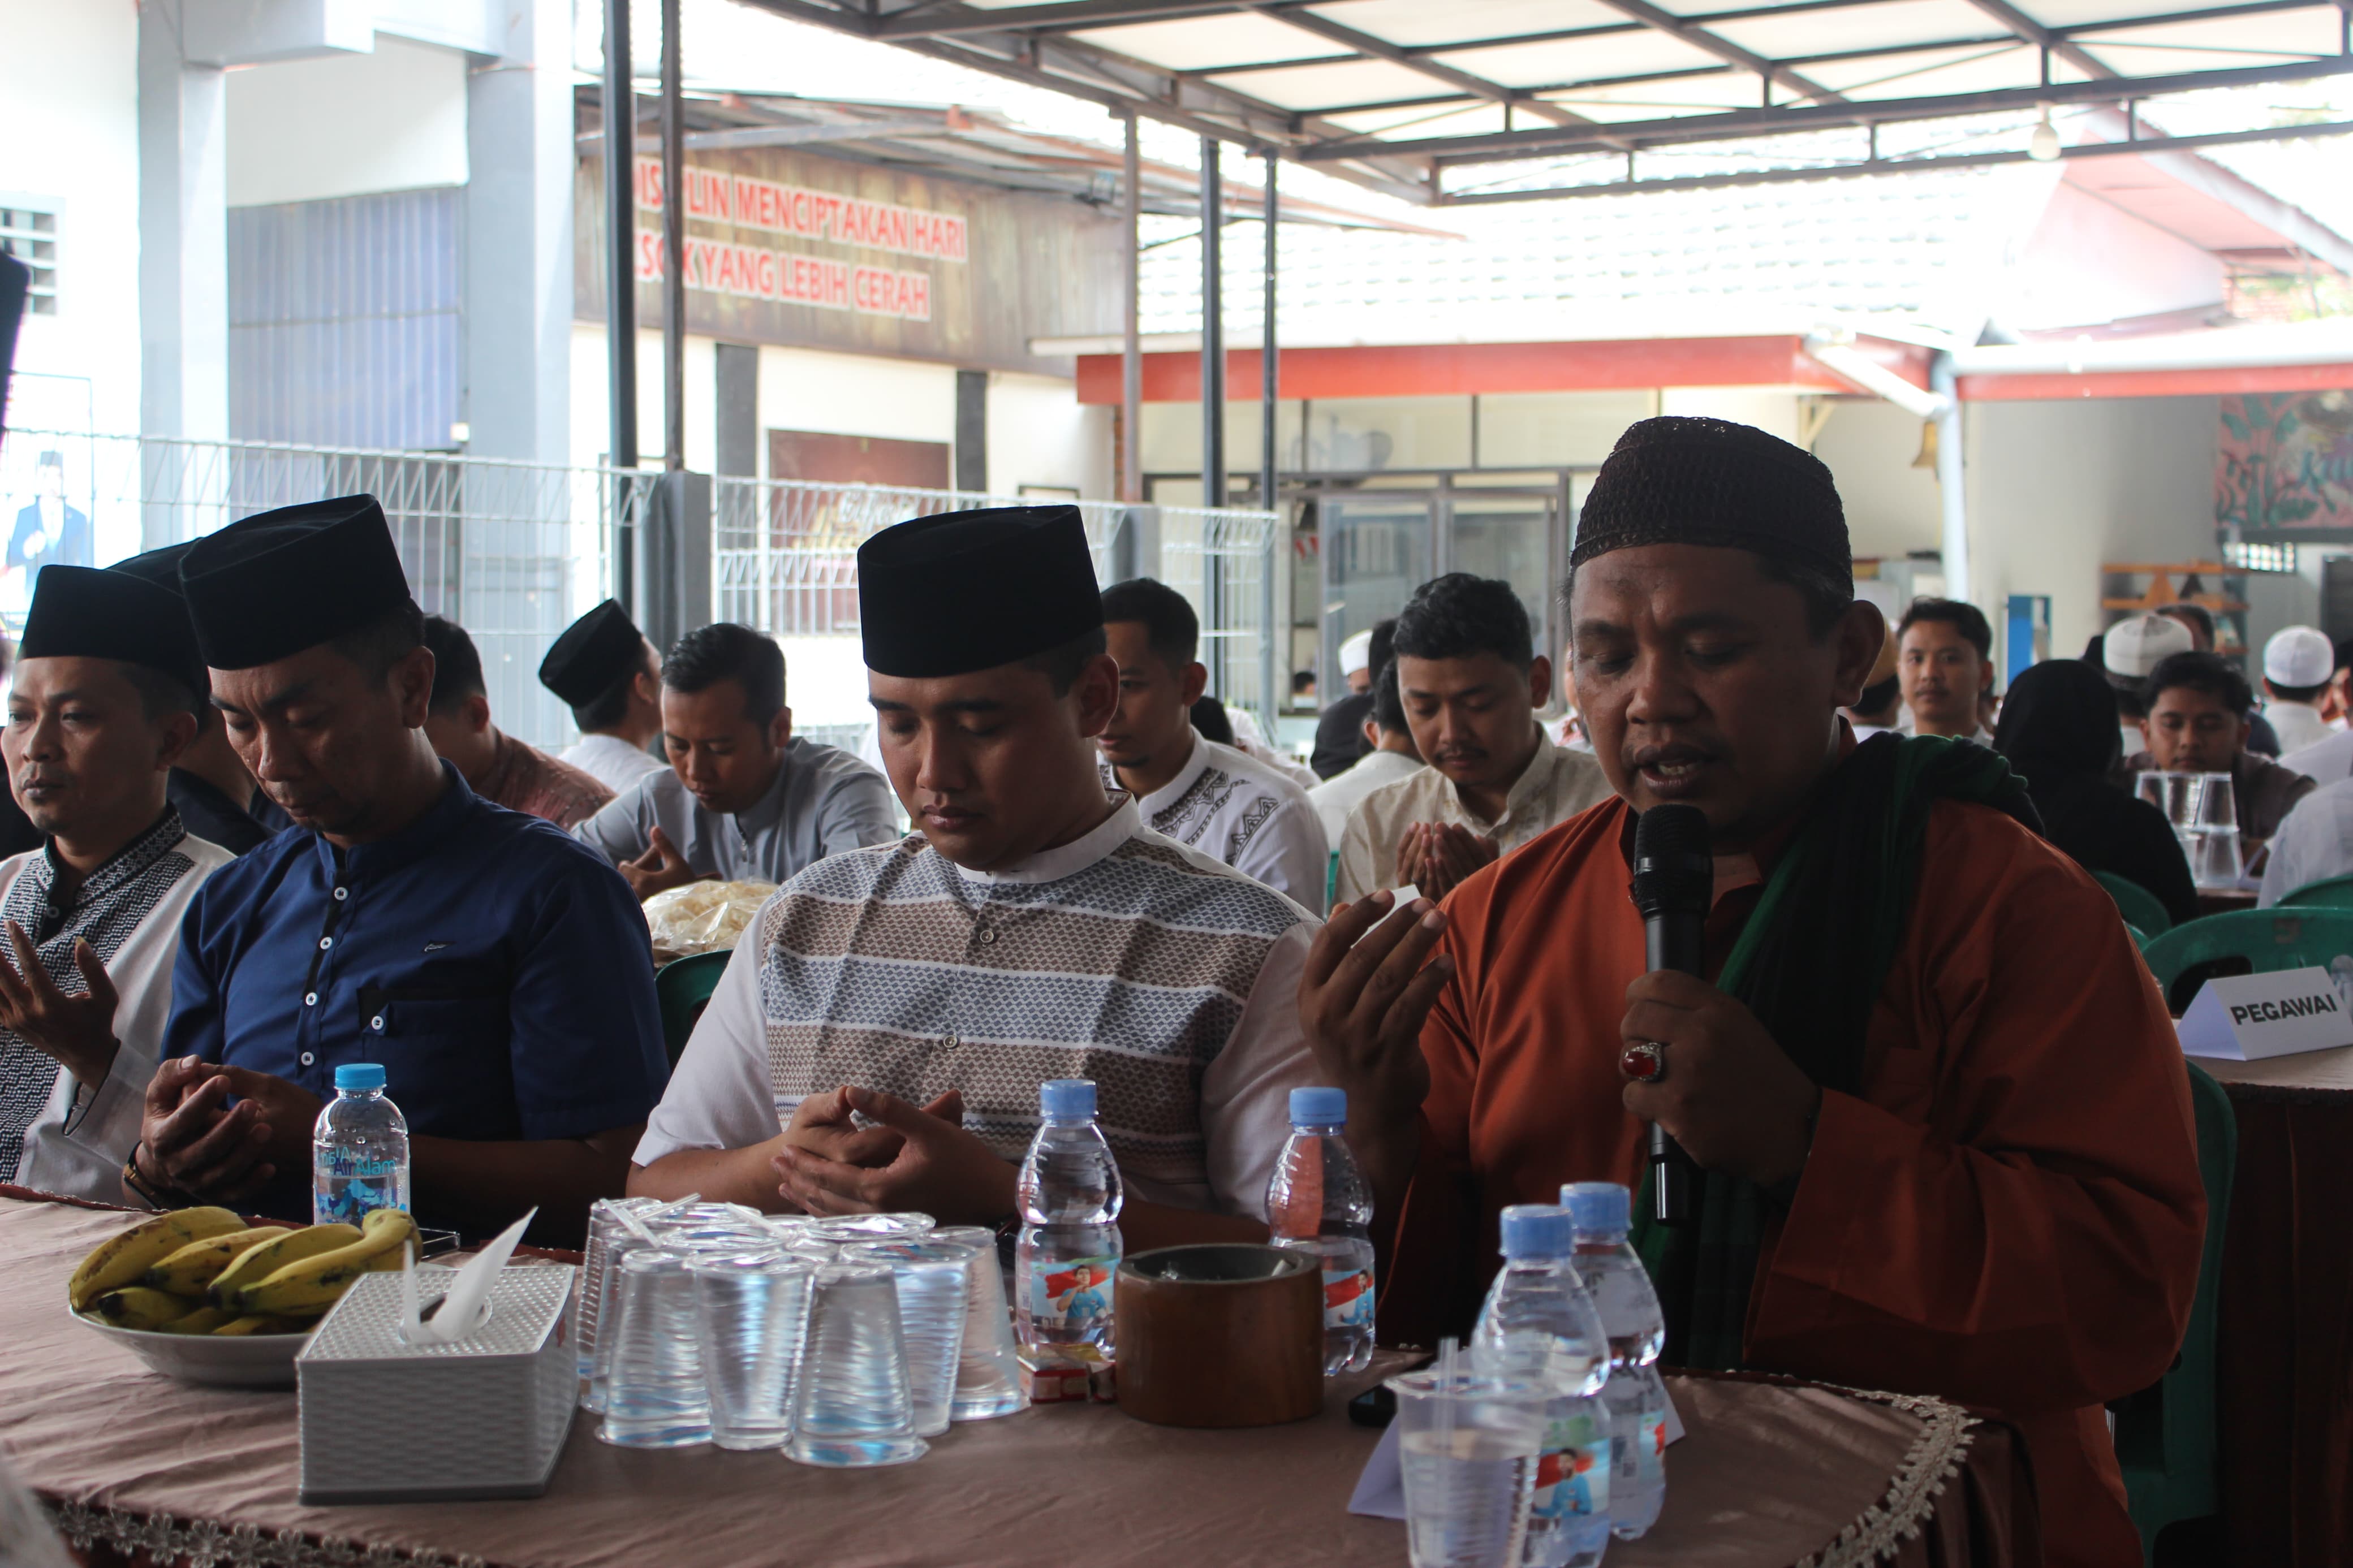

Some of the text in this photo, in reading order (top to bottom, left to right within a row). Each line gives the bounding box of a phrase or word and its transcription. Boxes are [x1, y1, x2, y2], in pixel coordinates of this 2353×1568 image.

[737, 181, 909, 249] MENCIPTAKAN
[912, 214, 966, 262] HARI
[699, 244, 775, 295] YANG
[781, 254, 848, 307] LEBIH
[855, 269, 928, 317] CERAH
[2230, 994, 2338, 1025] PEGAWAI
